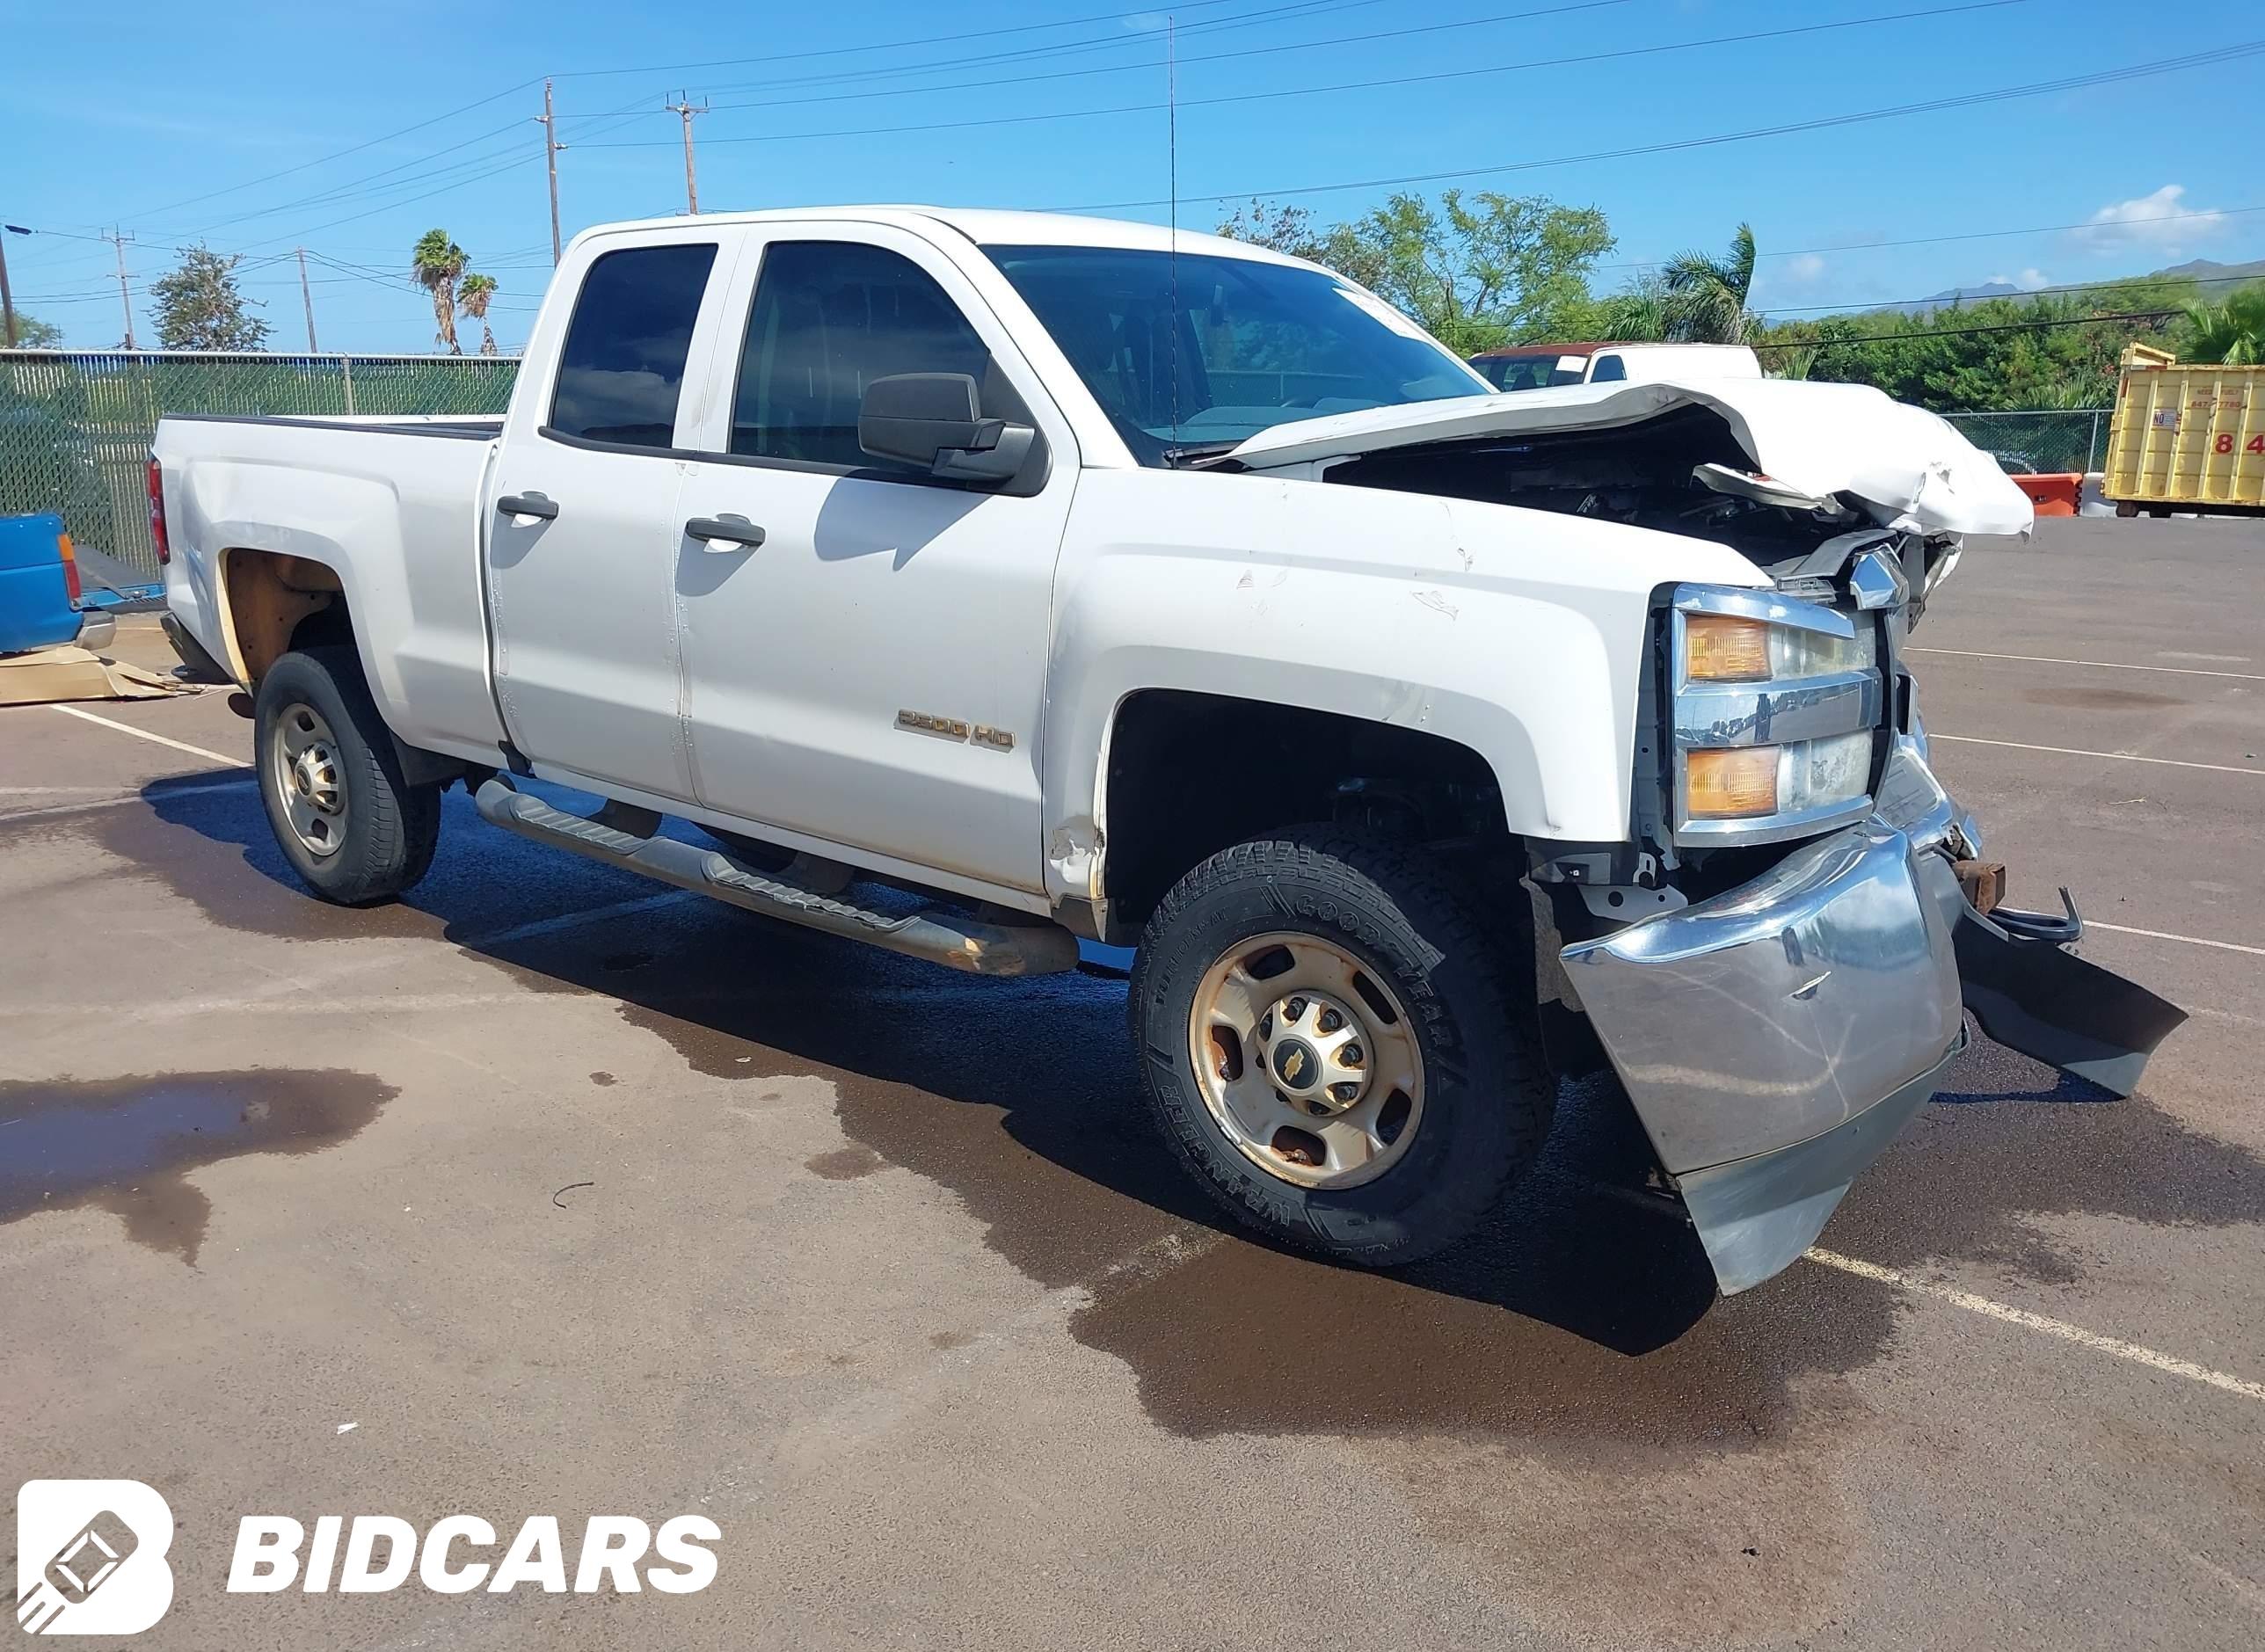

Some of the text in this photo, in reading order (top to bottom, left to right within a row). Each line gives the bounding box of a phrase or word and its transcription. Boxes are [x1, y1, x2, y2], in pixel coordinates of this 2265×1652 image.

[2153, 413, 2165, 424] NO
[974, 724, 1016, 747] HD
[1296, 893, 1453, 1048] GOODYEAR
[1158, 1084, 1292, 1228] WRANGLER
